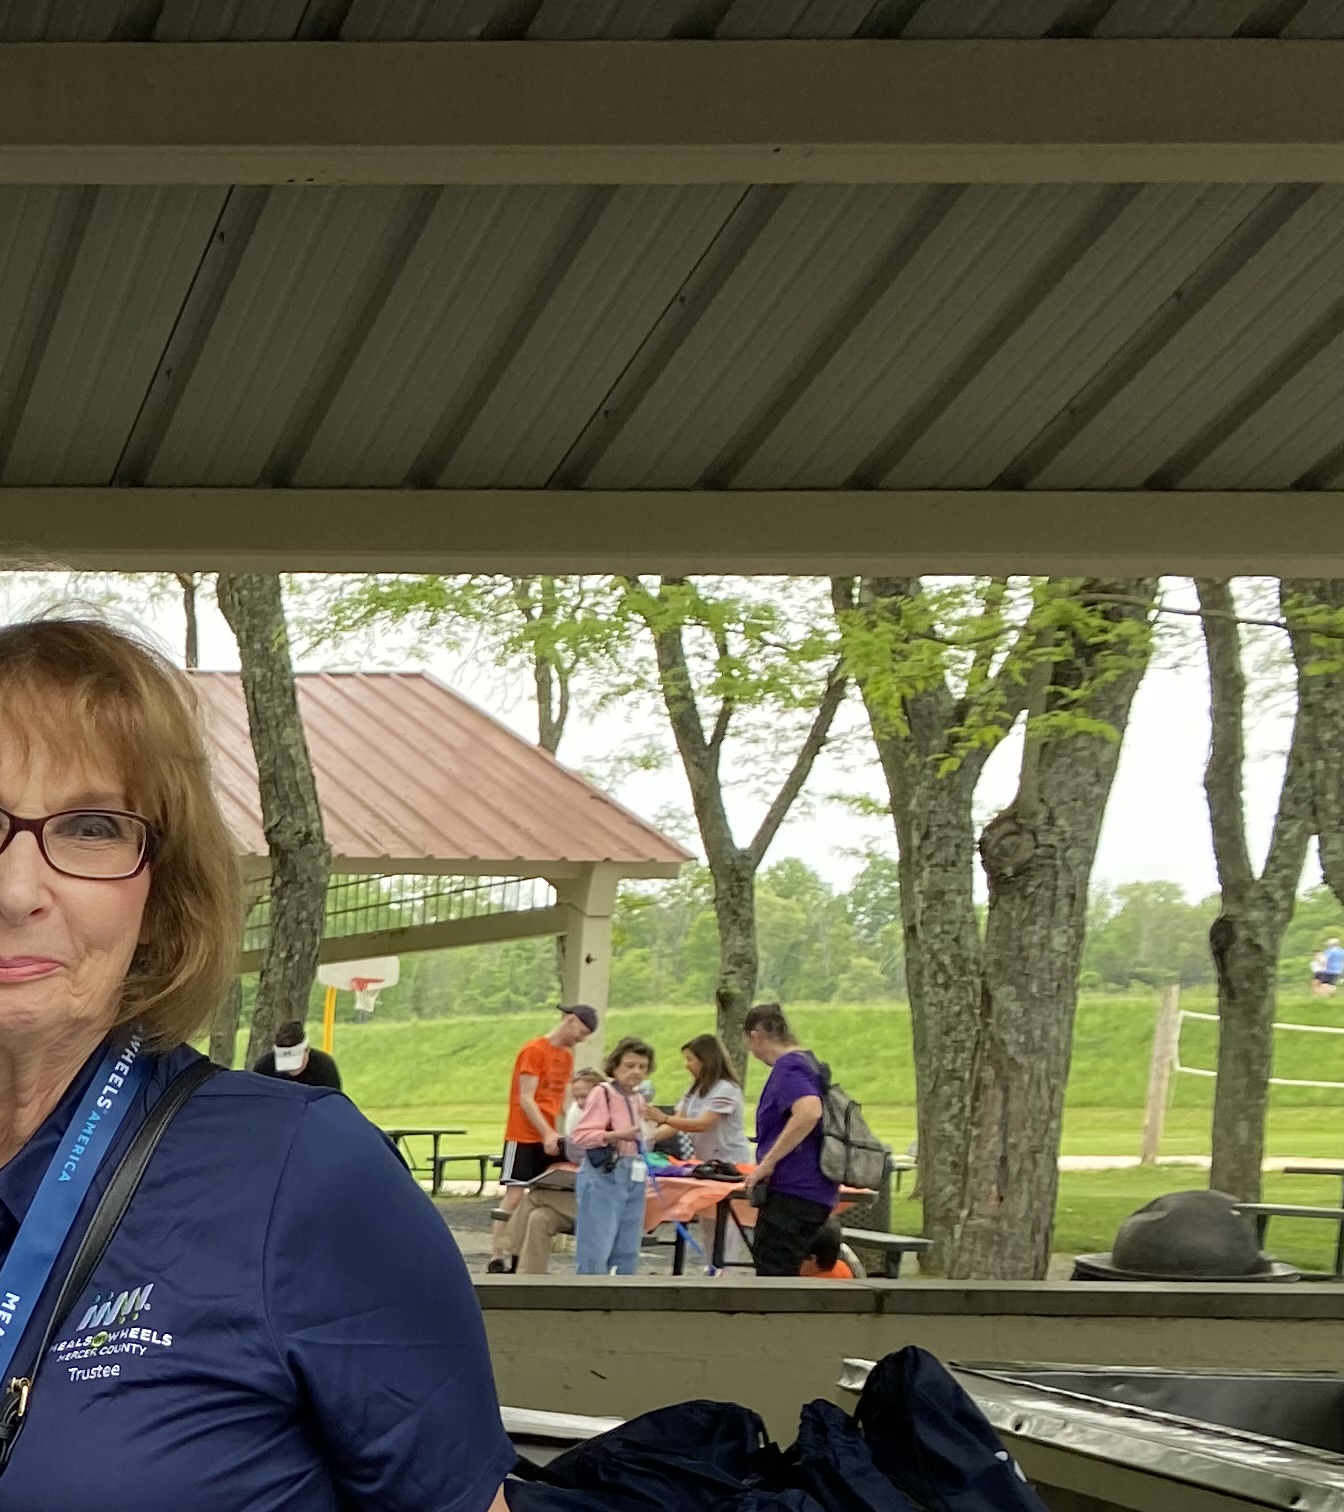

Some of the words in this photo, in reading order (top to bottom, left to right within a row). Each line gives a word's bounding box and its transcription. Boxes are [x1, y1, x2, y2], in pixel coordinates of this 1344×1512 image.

[58, 1109, 102, 1183] AMERICA
[108, 1327, 173, 1347] WHEELS
[98, 1342, 148, 1356] COUNTY
[68, 1363, 121, 1382] Trustee
